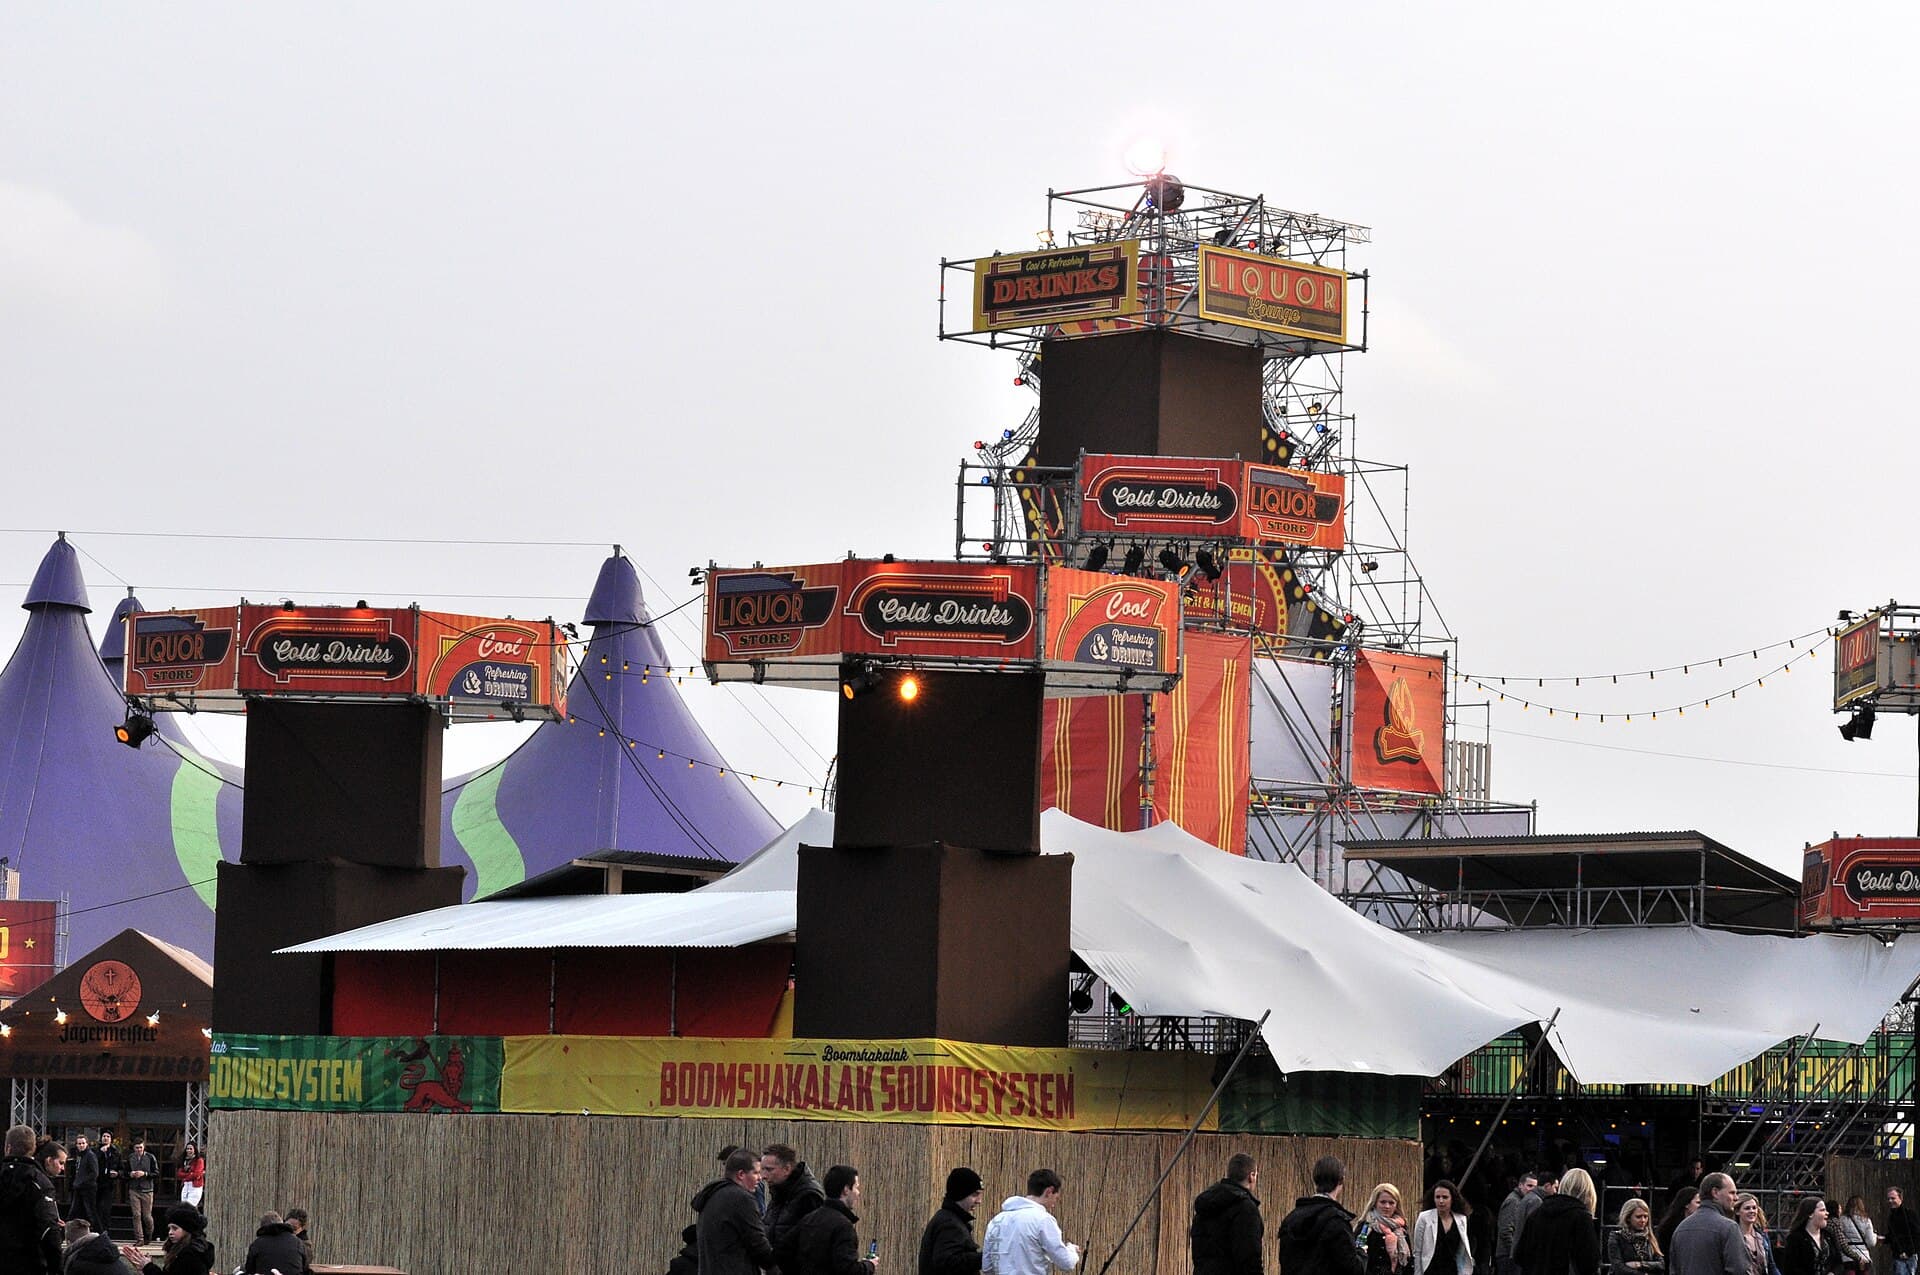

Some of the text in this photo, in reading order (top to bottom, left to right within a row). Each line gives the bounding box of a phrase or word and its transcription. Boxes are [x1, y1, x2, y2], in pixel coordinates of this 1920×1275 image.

[1048, 256, 1085, 270] Refreshing
[993, 265, 1119, 304] DRINKS
[1208, 258, 1337, 311] LIQUOR
[1248, 296, 1301, 326] Lounge
[1112, 487, 1222, 510] Cold Drinks
[1251, 486, 1317, 519] LIQUOR
[1267, 520, 1308, 534] STORE
[718, 592, 803, 628] LIQUOR
[878, 599, 1014, 627] Cold Drinks
[1105, 591, 1150, 620] Cool
[136, 633, 205, 664] LIQUOR
[273, 639, 394, 665] Cold Drinks
[478, 632, 522, 657] Cool
[738, 632, 791, 646] STORE
[1090, 628, 1156, 660] & Refreshing
[1111, 646, 1155, 667] DRINKS
[152, 669, 194, 681] STORE
[462, 665, 528, 695] & Refreshing
[484, 681, 528, 700] DRINKS
[1856, 870, 1894, 892] Cold
[59, 1023, 158, 1044] Jägermeister
[821, 1045, 910, 1063] Boomshakalak
[660, 1061, 1075, 1120] BOOMSHAKALAK SOUNDSYSTEM
